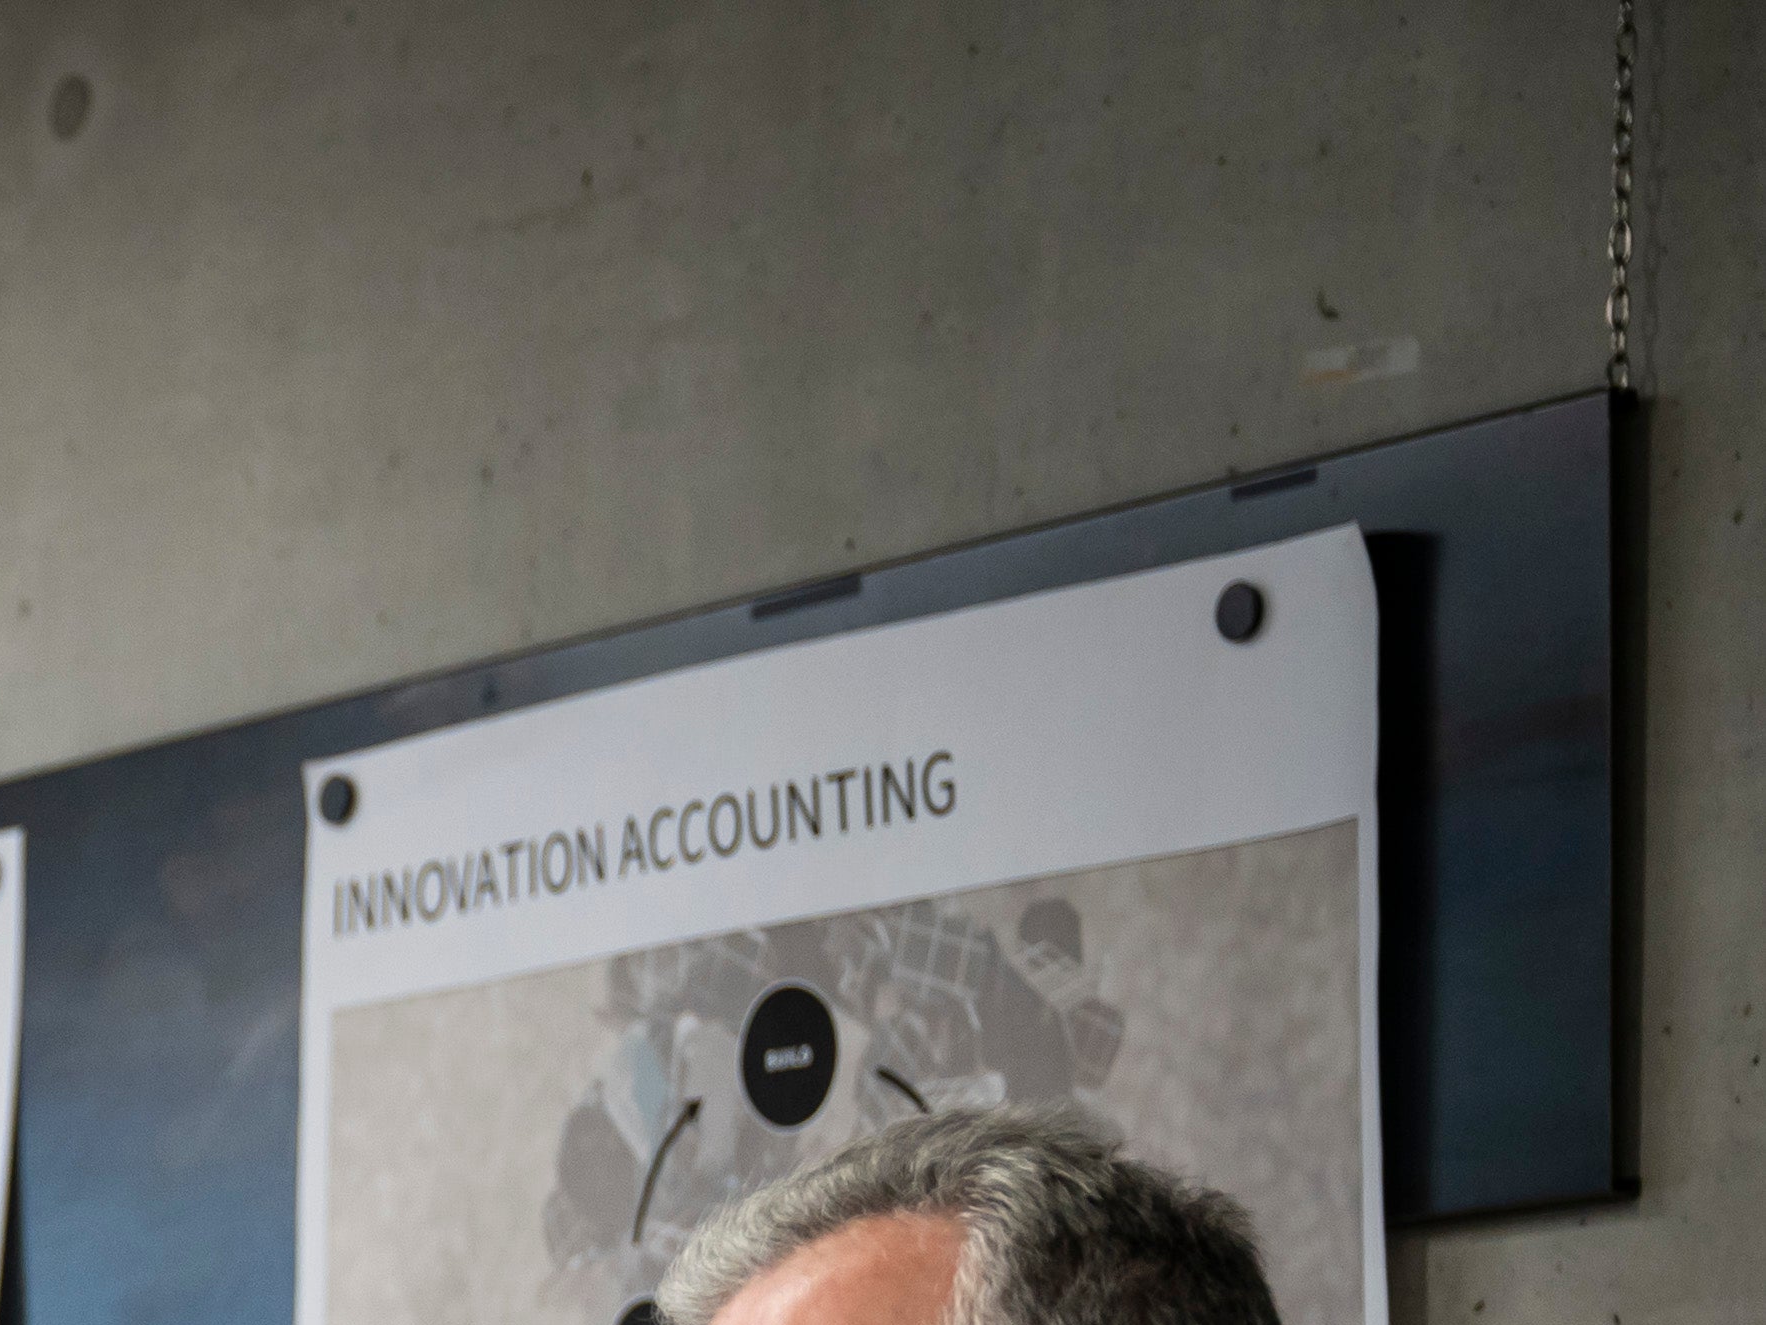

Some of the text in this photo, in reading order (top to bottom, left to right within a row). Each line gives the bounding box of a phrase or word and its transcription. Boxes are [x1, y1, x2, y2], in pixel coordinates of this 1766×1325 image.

[332, 749, 957, 938] INNOVATION ACCOUNTING
[764, 1043, 814, 1073] BUILD
